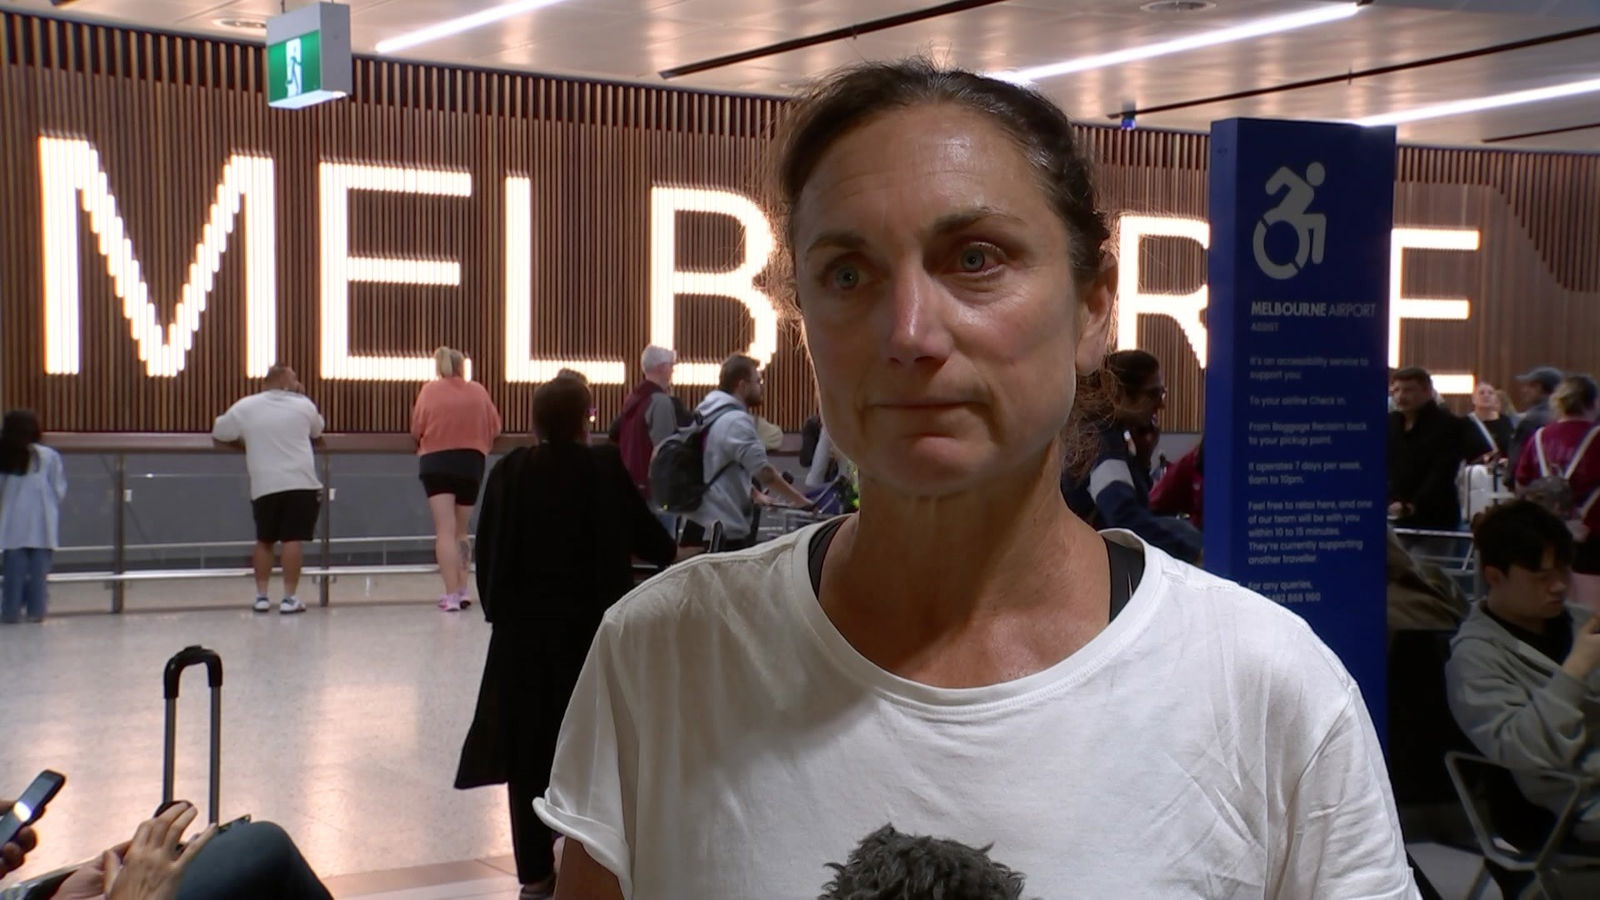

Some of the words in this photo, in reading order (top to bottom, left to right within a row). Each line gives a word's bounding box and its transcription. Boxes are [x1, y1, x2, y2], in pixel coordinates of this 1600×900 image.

[38, 130, 1480, 394] MELBRE
[1251, 301, 1326, 316] MELBOURNE
[1328, 302, 1378, 318] AIRPORT
[1250, 322, 1279, 332] ASSIST
[1277, 357, 1328, 368] accessibility
[1329, 358, 1359, 366] service
[1360, 358, 1369, 367] to
[1250, 371, 1282, 381] support
[1250, 395, 1261, 405] To
[1261, 397, 1280, 407] your
[1309, 396, 1335, 405] Check
[1249, 422, 1271, 431] From
[1272, 422, 1310, 434] Baggage
[1312, 422, 1345, 431] Reclaim
[1346, 422, 1367, 431] back
[1248, 436, 1258, 445] to
[1259, 437, 1278, 447] your
[1280, 435, 1308, 446] pickup
[1256, 462, 1293, 473] operates
[1295, 460, 1300, 470] 7
[1301, 462, 1322, 472] days
[1323, 462, 1337, 472] per
[1270, 475, 1279, 484] to
[1248, 501, 1265, 511] Feel
[1267, 501, 1283, 510] free
[1285, 501, 1293, 510] to
[1295, 501, 1315, 509] relax
[1338, 500, 1355, 509] and
[1248, 515, 1257, 524] of
[1258, 516, 1272, 524] our
[1274, 515, 1296, 523] team
[1298, 513, 1312, 523] will
[1313, 514, 1324, 523] be
[1326, 513, 1343, 522] with
[1344, 514, 1360, 524] you
[1248, 528, 1273, 537] within
[1275, 527, 1283, 537] 10
[1285, 528, 1294, 536] to
[1249, 542, 1278, 553] They're
[1280, 541, 1317, 551] currently
[1318, 540, 1363, 551] supporting
[1248, 555, 1281, 565] another
[1248, 582, 1261, 590] For
[1263, 583, 1279, 592] any
